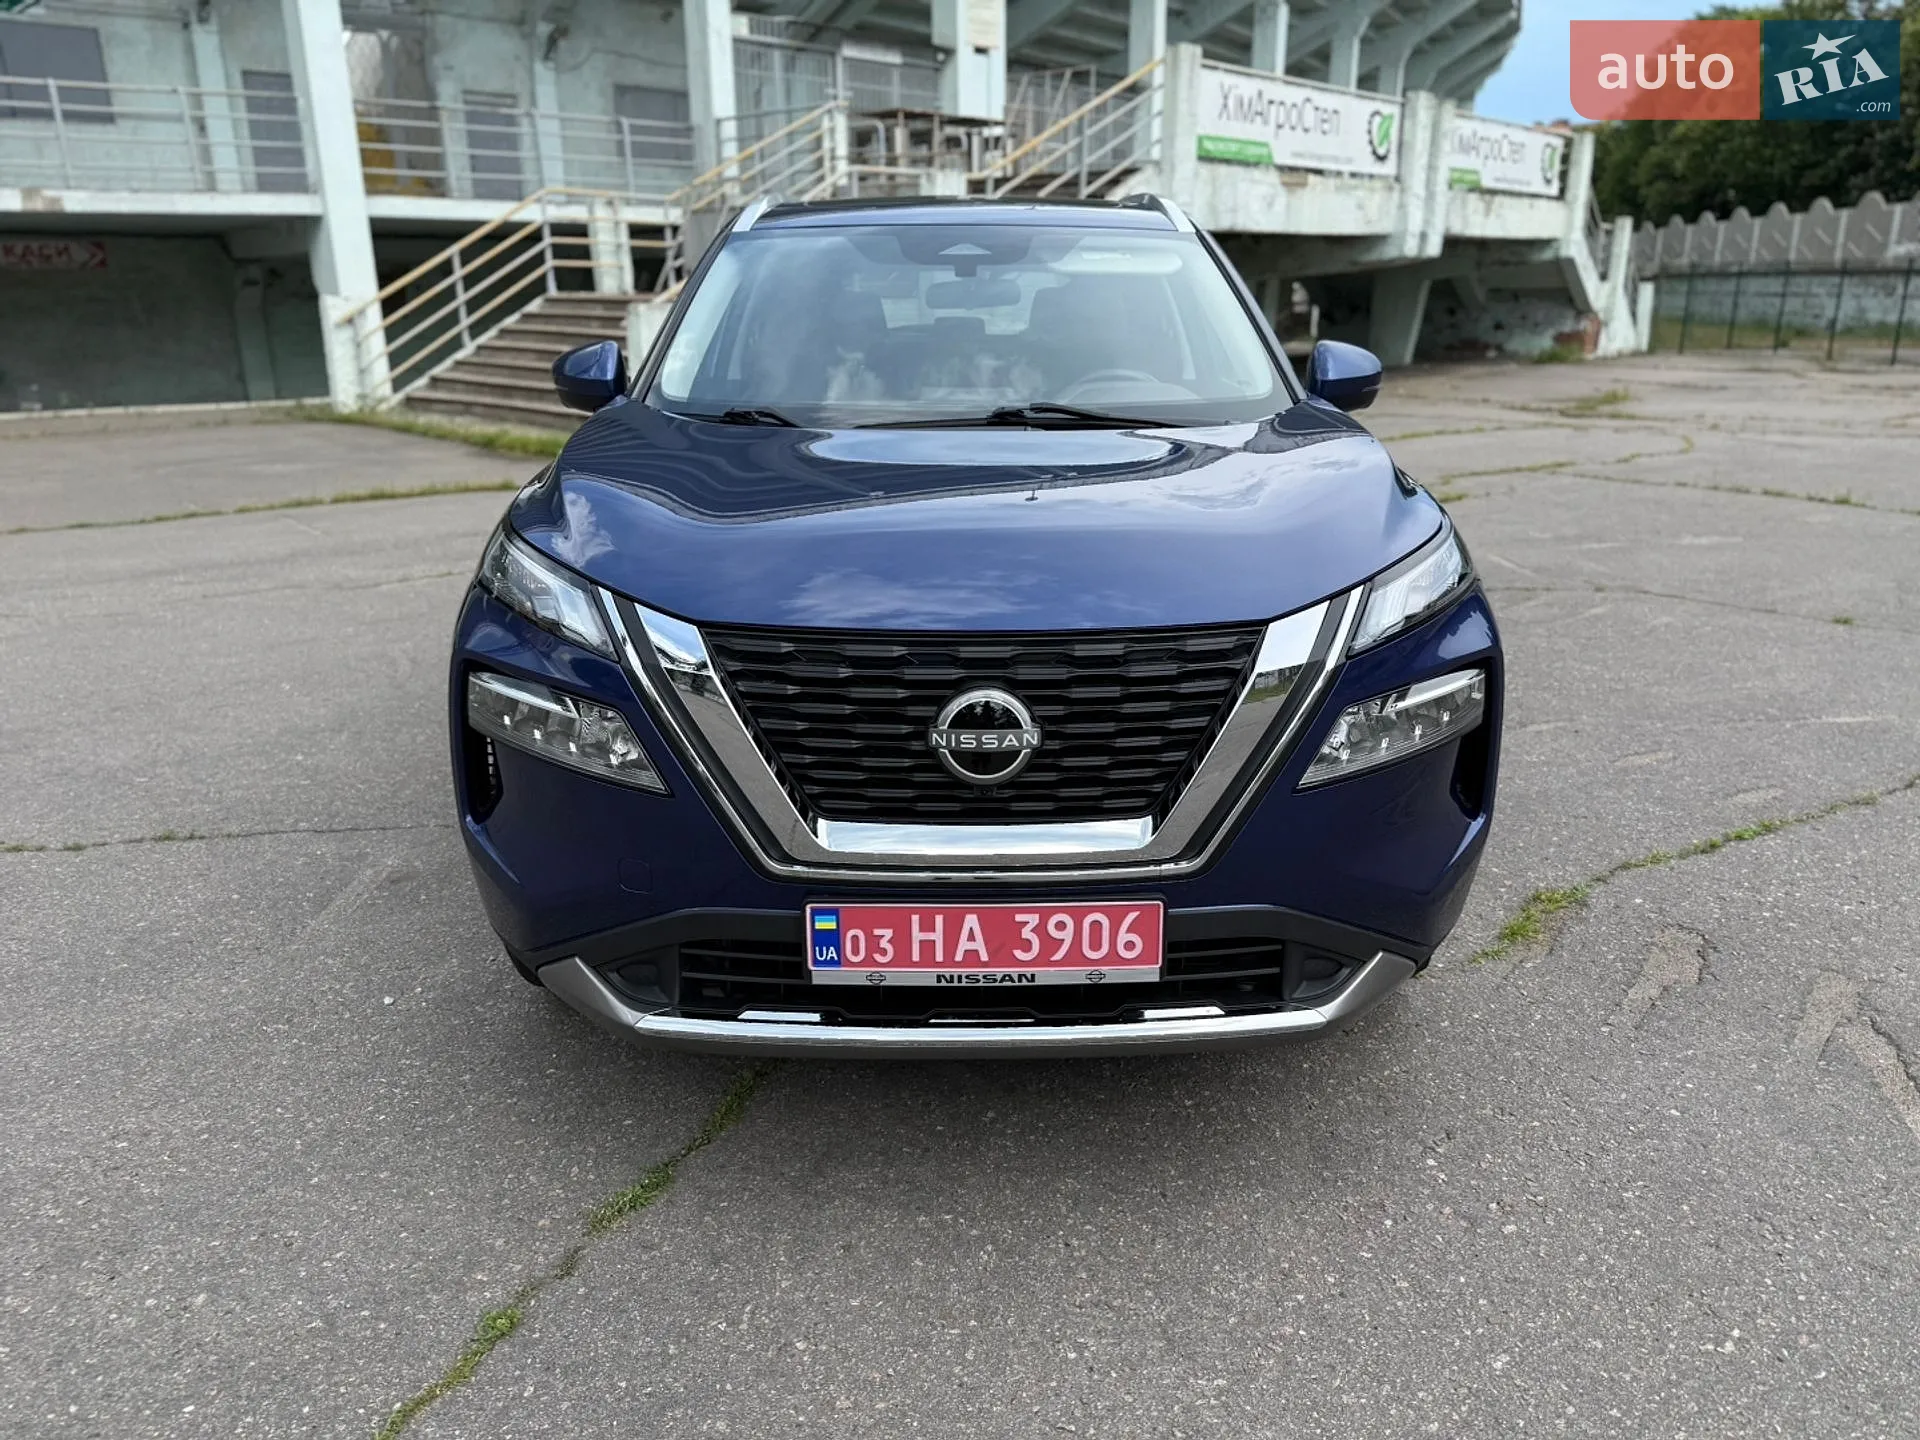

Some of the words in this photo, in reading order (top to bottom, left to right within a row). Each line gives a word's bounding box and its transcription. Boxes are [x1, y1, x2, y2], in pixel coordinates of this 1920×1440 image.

[1218, 80, 1342, 140] ХімАгроСтеп
[931, 732, 1038, 748] NISSAN
[845, 928, 895, 964] 03
[911, 913, 990, 963] HA
[1012, 910, 1144, 962] 3906
[815, 946, 838, 961] UA
[935, 972, 1037, 985] NISSAN
